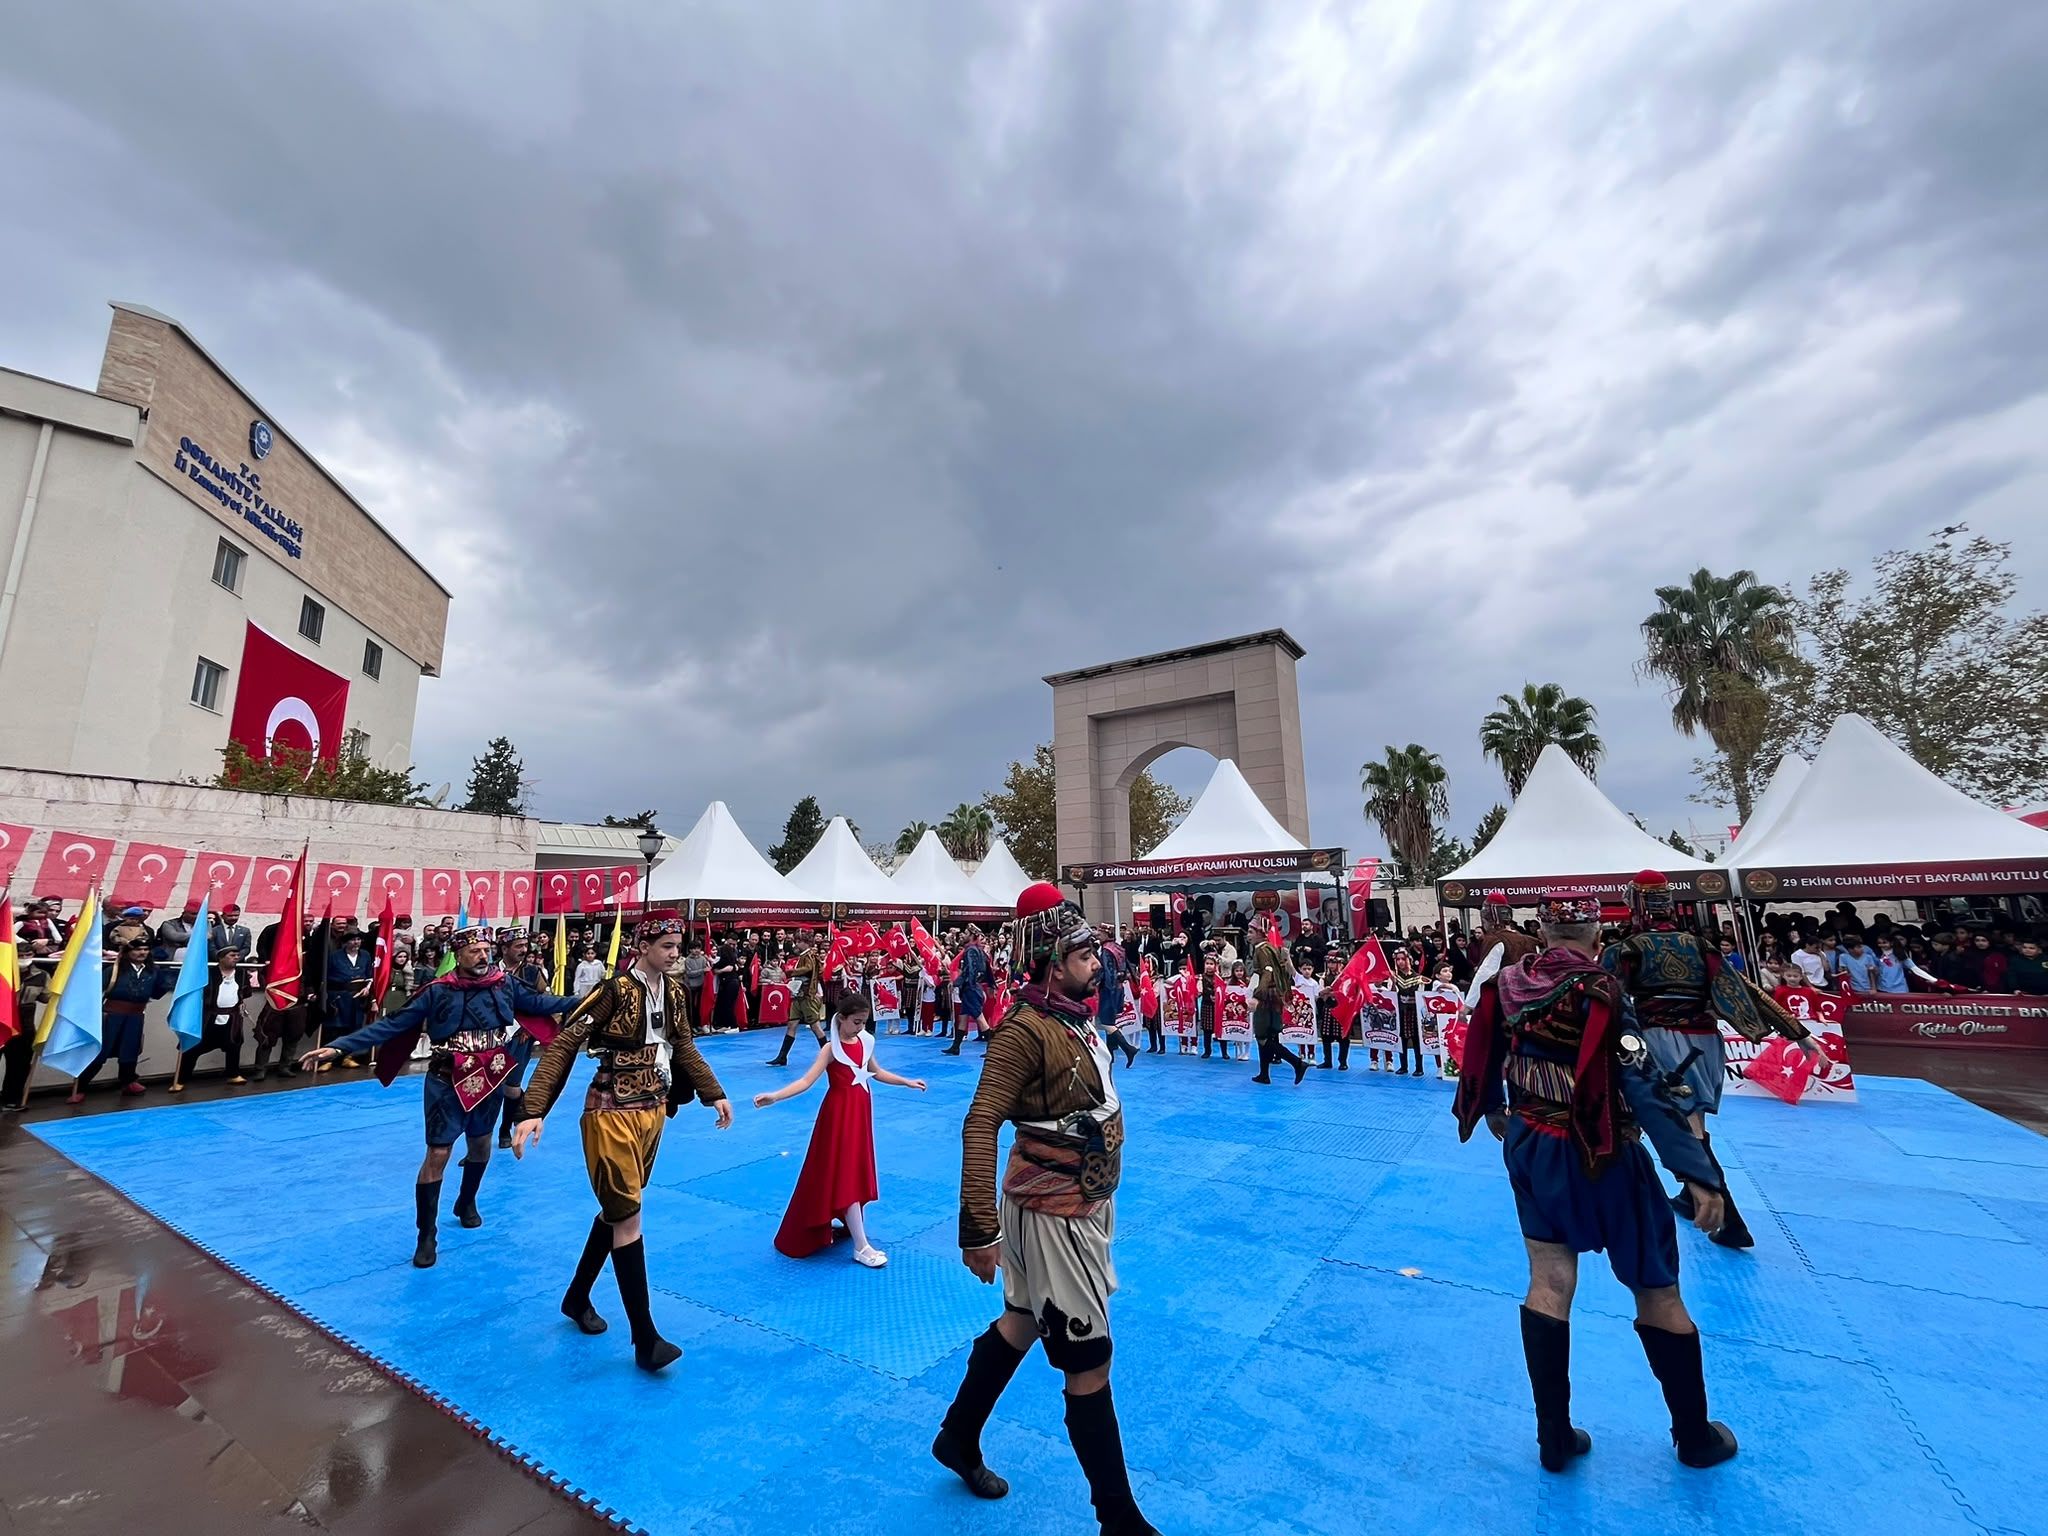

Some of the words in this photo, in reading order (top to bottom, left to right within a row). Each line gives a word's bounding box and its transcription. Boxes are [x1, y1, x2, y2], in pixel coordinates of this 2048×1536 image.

[180, 436, 253, 502] OSMANİYE
[174, 449, 187, 473] İl
[189, 464, 243, 515] Emniyet
[1093, 868, 1104, 877] 29
[1106, 868, 1126, 877] EKİM
[1128, 863, 1184, 876] CUMHURİYET
[1186, 862, 1228, 872] BAYRAMI
[1229, 859, 1262, 869] KUTLU
[1262, 857, 1298, 868] OLSUN
[1668, 882, 1691, 890] SUN
[1783, 878, 1797, 887] 29
[1801, 876, 1832, 887] EKİM
[1834, 874, 1922, 886] CUMHURİYET
[1925, 872, 1989, 883] BAYRAMI
[1990, 870, 2040, 880] KUTLU
[1852, 1000, 1894, 1013] EKİM
[1901, 1002, 2012, 1017] CUMHURİYET
[1910, 1022, 1958, 1038] Kutlu
[1958, 1020, 2008, 1036] Olsun
